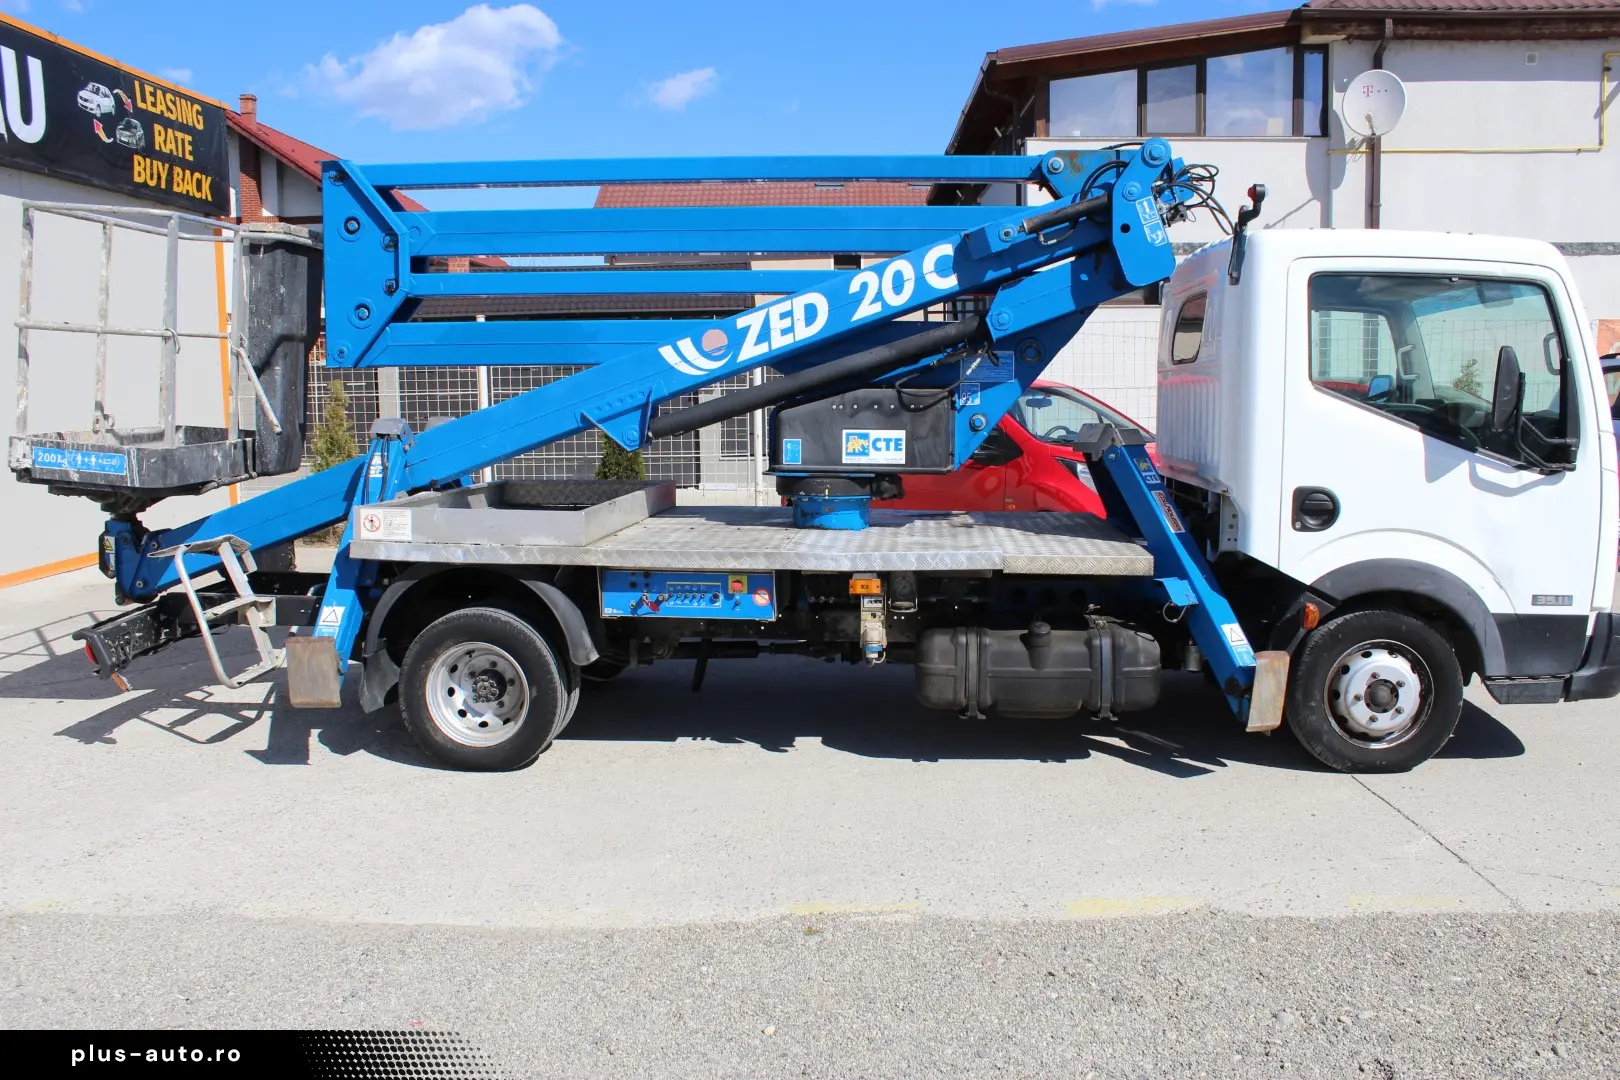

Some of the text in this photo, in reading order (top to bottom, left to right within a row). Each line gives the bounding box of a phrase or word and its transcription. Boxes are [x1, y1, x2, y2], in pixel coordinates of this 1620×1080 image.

[0, 44, 47, 144] U
[134, 79, 205, 131] LEASING
[153, 122, 194, 162] RATE
[133, 154, 213, 202] BUY BACK
[736, 291, 829, 363] ZED
[848, 258, 915, 322] 20
[871, 437, 903, 452] CTE
[1536, 595, 1569, 605] 35.11
